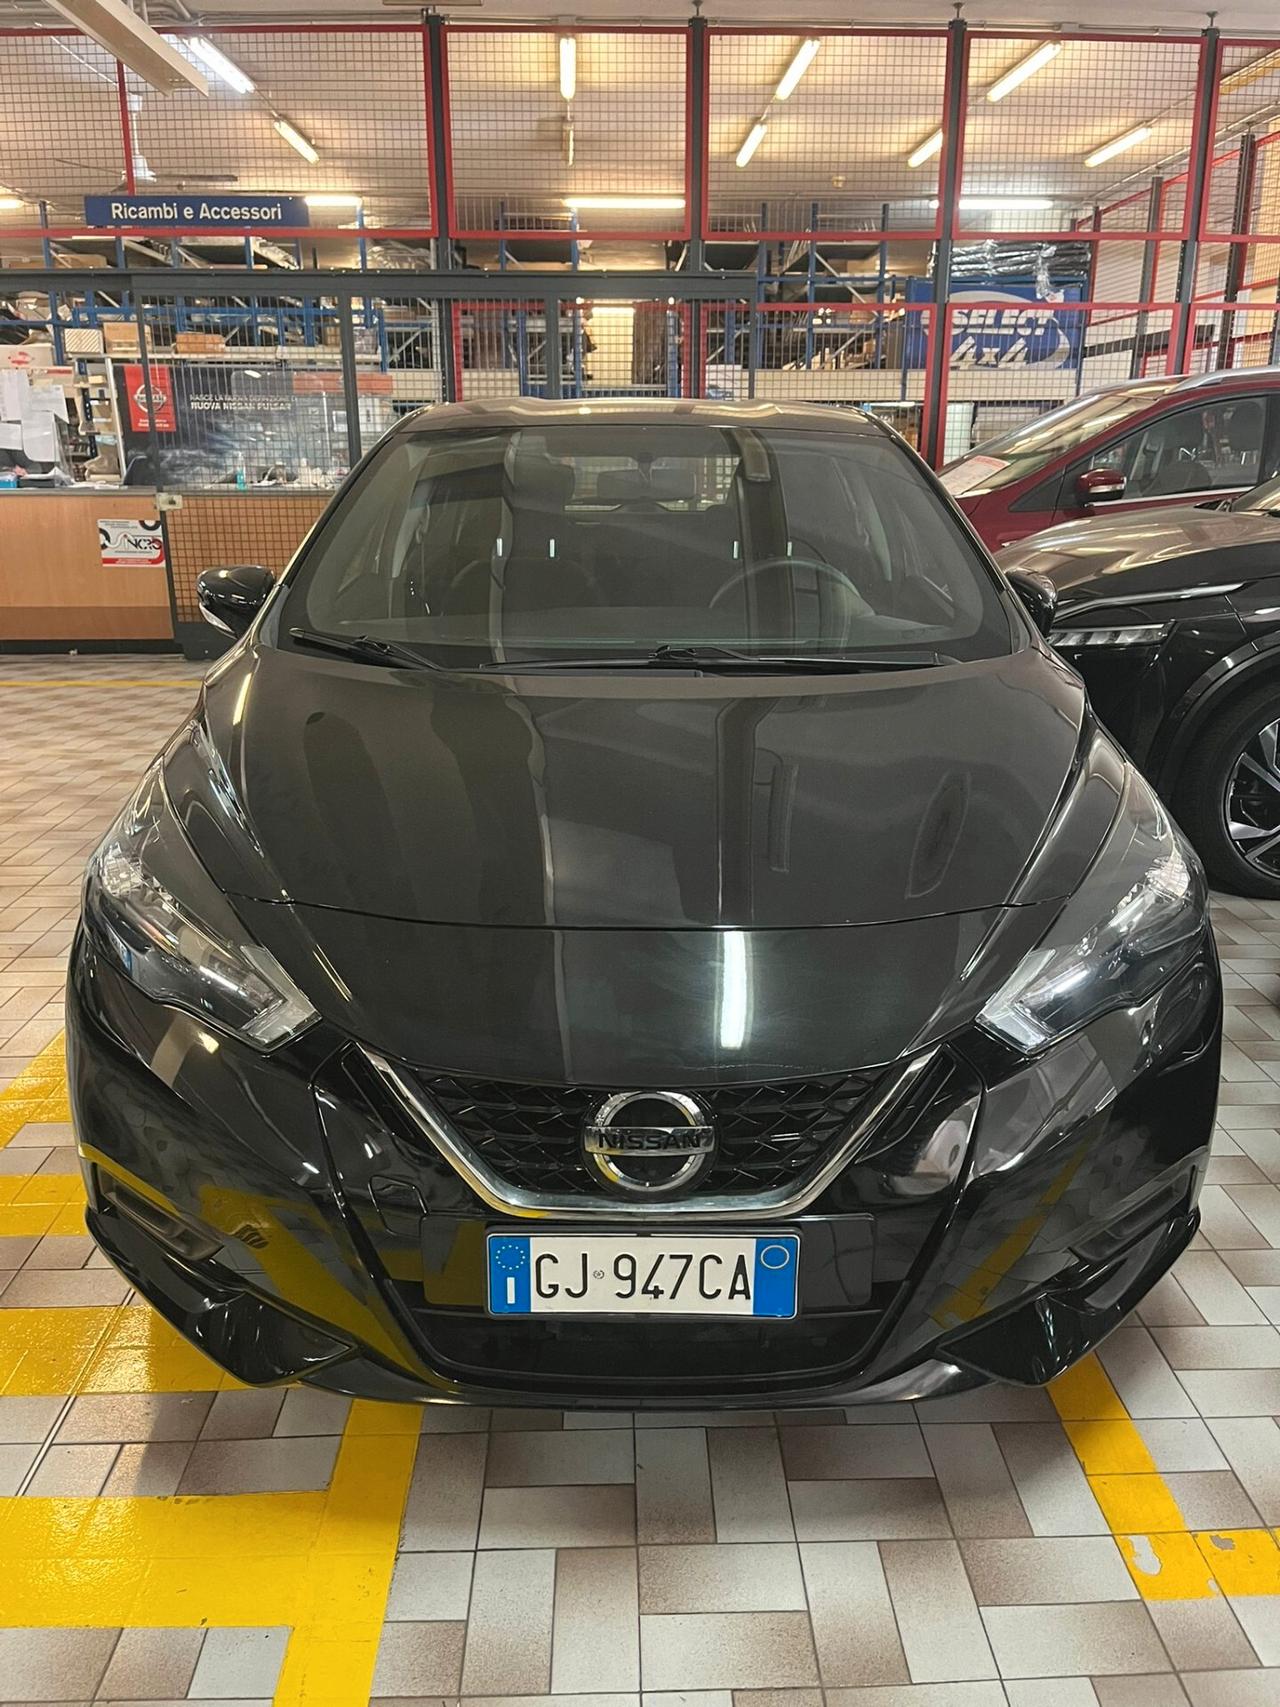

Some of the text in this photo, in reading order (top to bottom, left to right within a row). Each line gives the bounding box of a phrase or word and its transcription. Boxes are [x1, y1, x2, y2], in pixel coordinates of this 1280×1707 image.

[111, 203, 282, 220] Ricambi e Accessori
[951, 308, 1054, 336] SELECT
[949, 336, 1028, 370] 4x4
[191, 402, 221, 411] NUOVA
[223, 402, 255, 411] NISSAN
[599, 1131, 701, 1149] NISSAN
